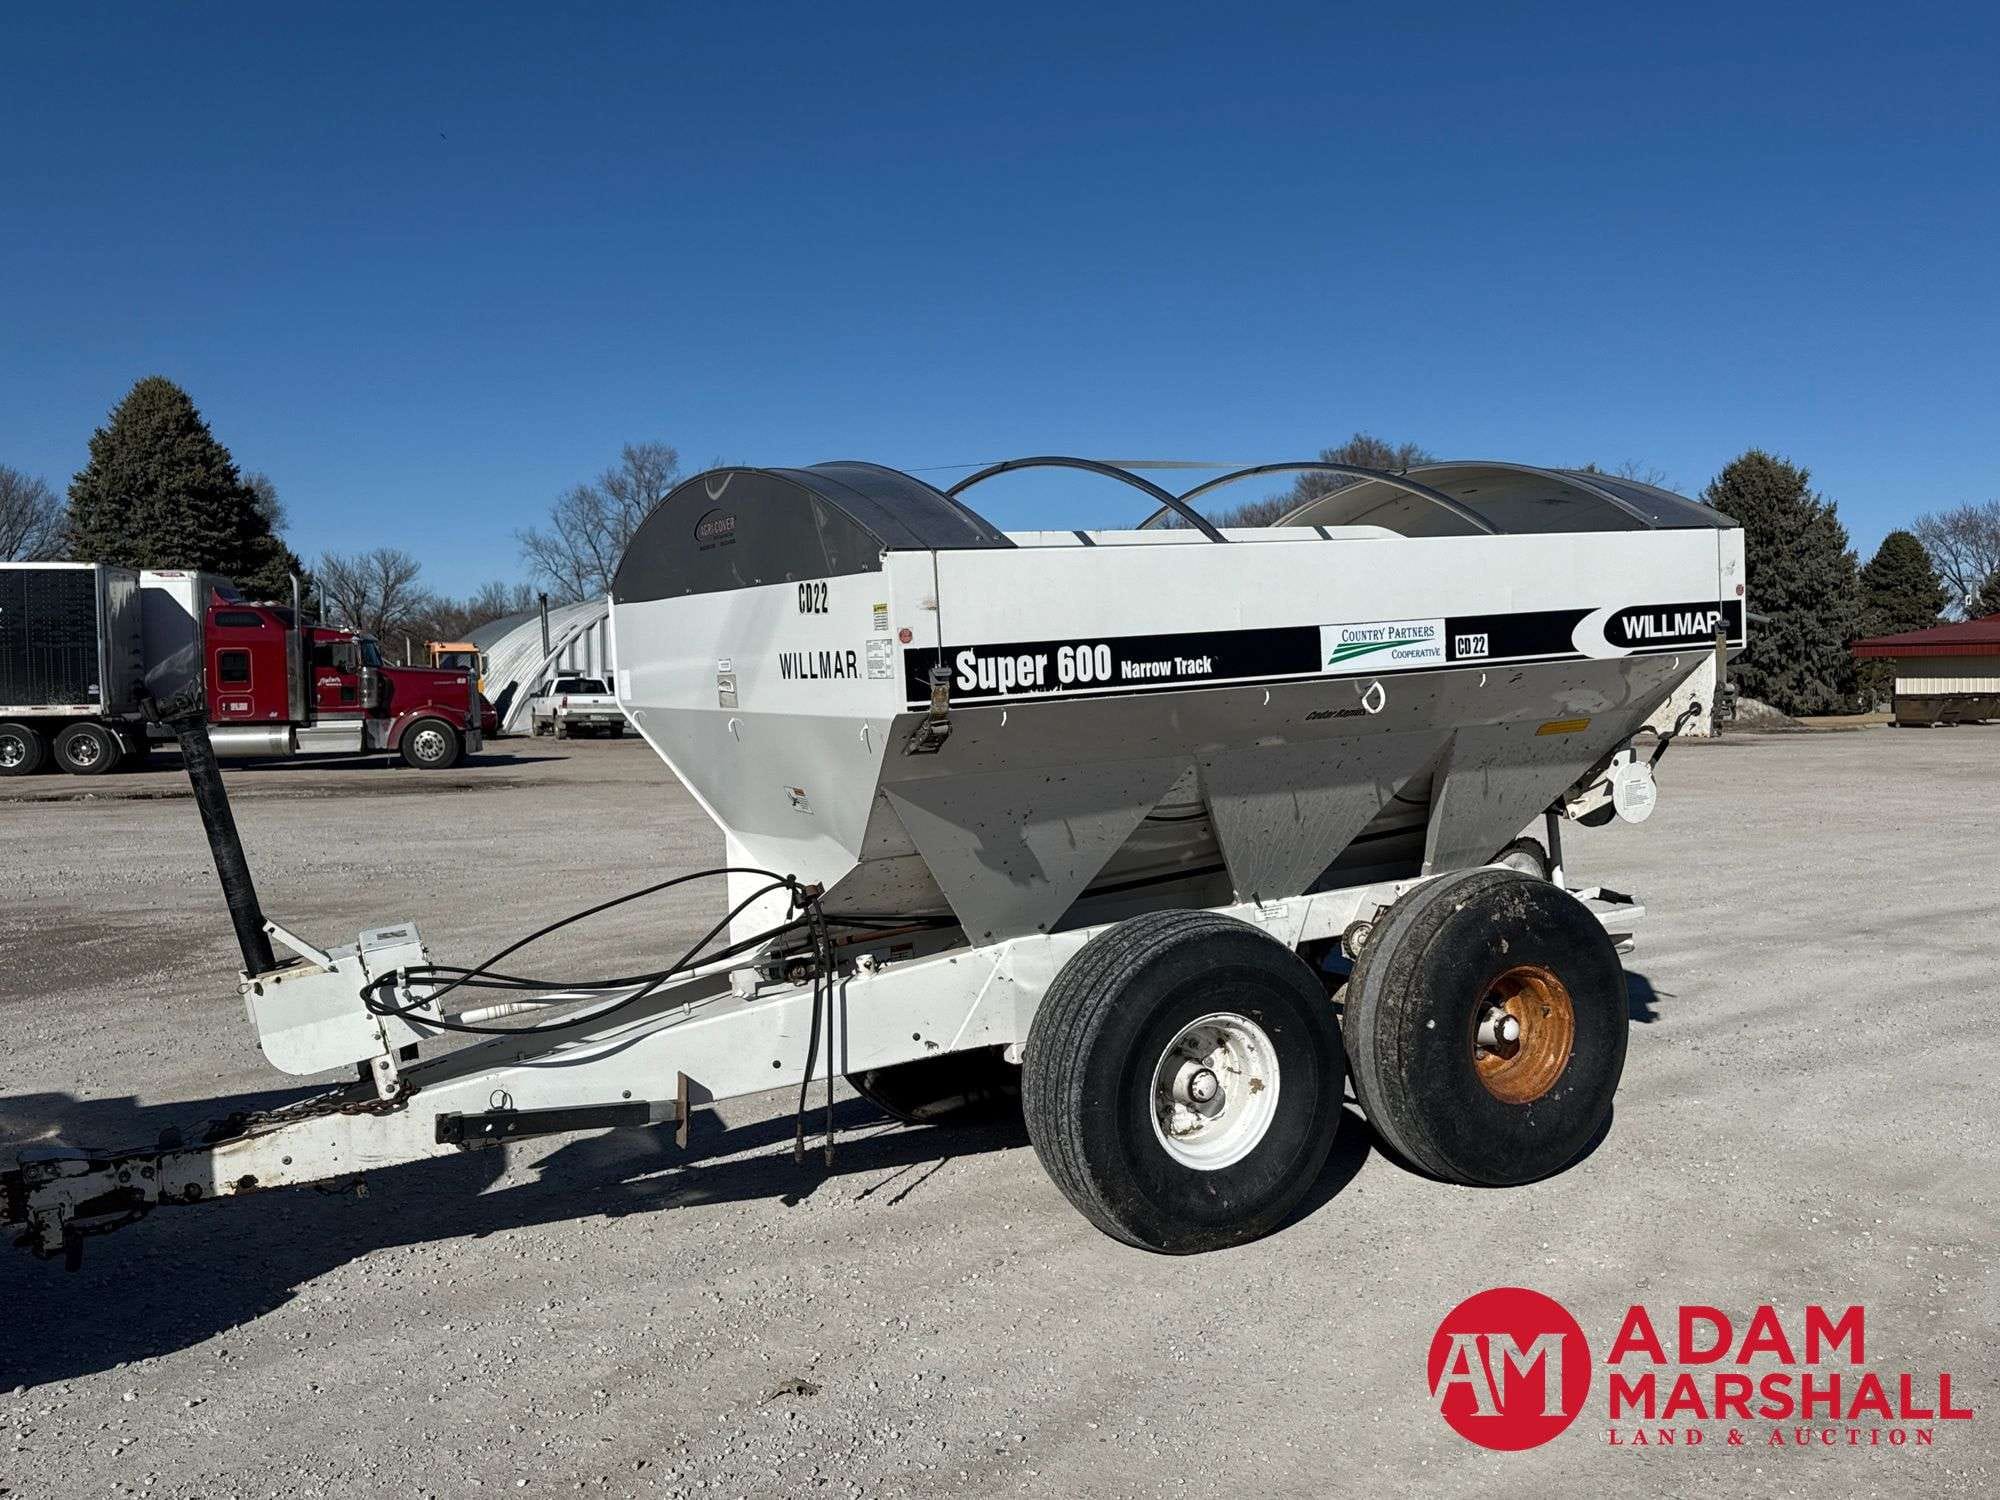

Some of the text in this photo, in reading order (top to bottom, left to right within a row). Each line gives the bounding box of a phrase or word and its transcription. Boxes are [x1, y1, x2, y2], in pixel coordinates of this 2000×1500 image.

[798, 582, 828, 613] CD22
[1388, 625, 1435, 640] PARTNERS
[1622, 611, 1721, 639] WILLMAR
[779, 650, 859, 680] WILLMAR
[956, 644, 1212, 694] Super 600 Narrow Track
